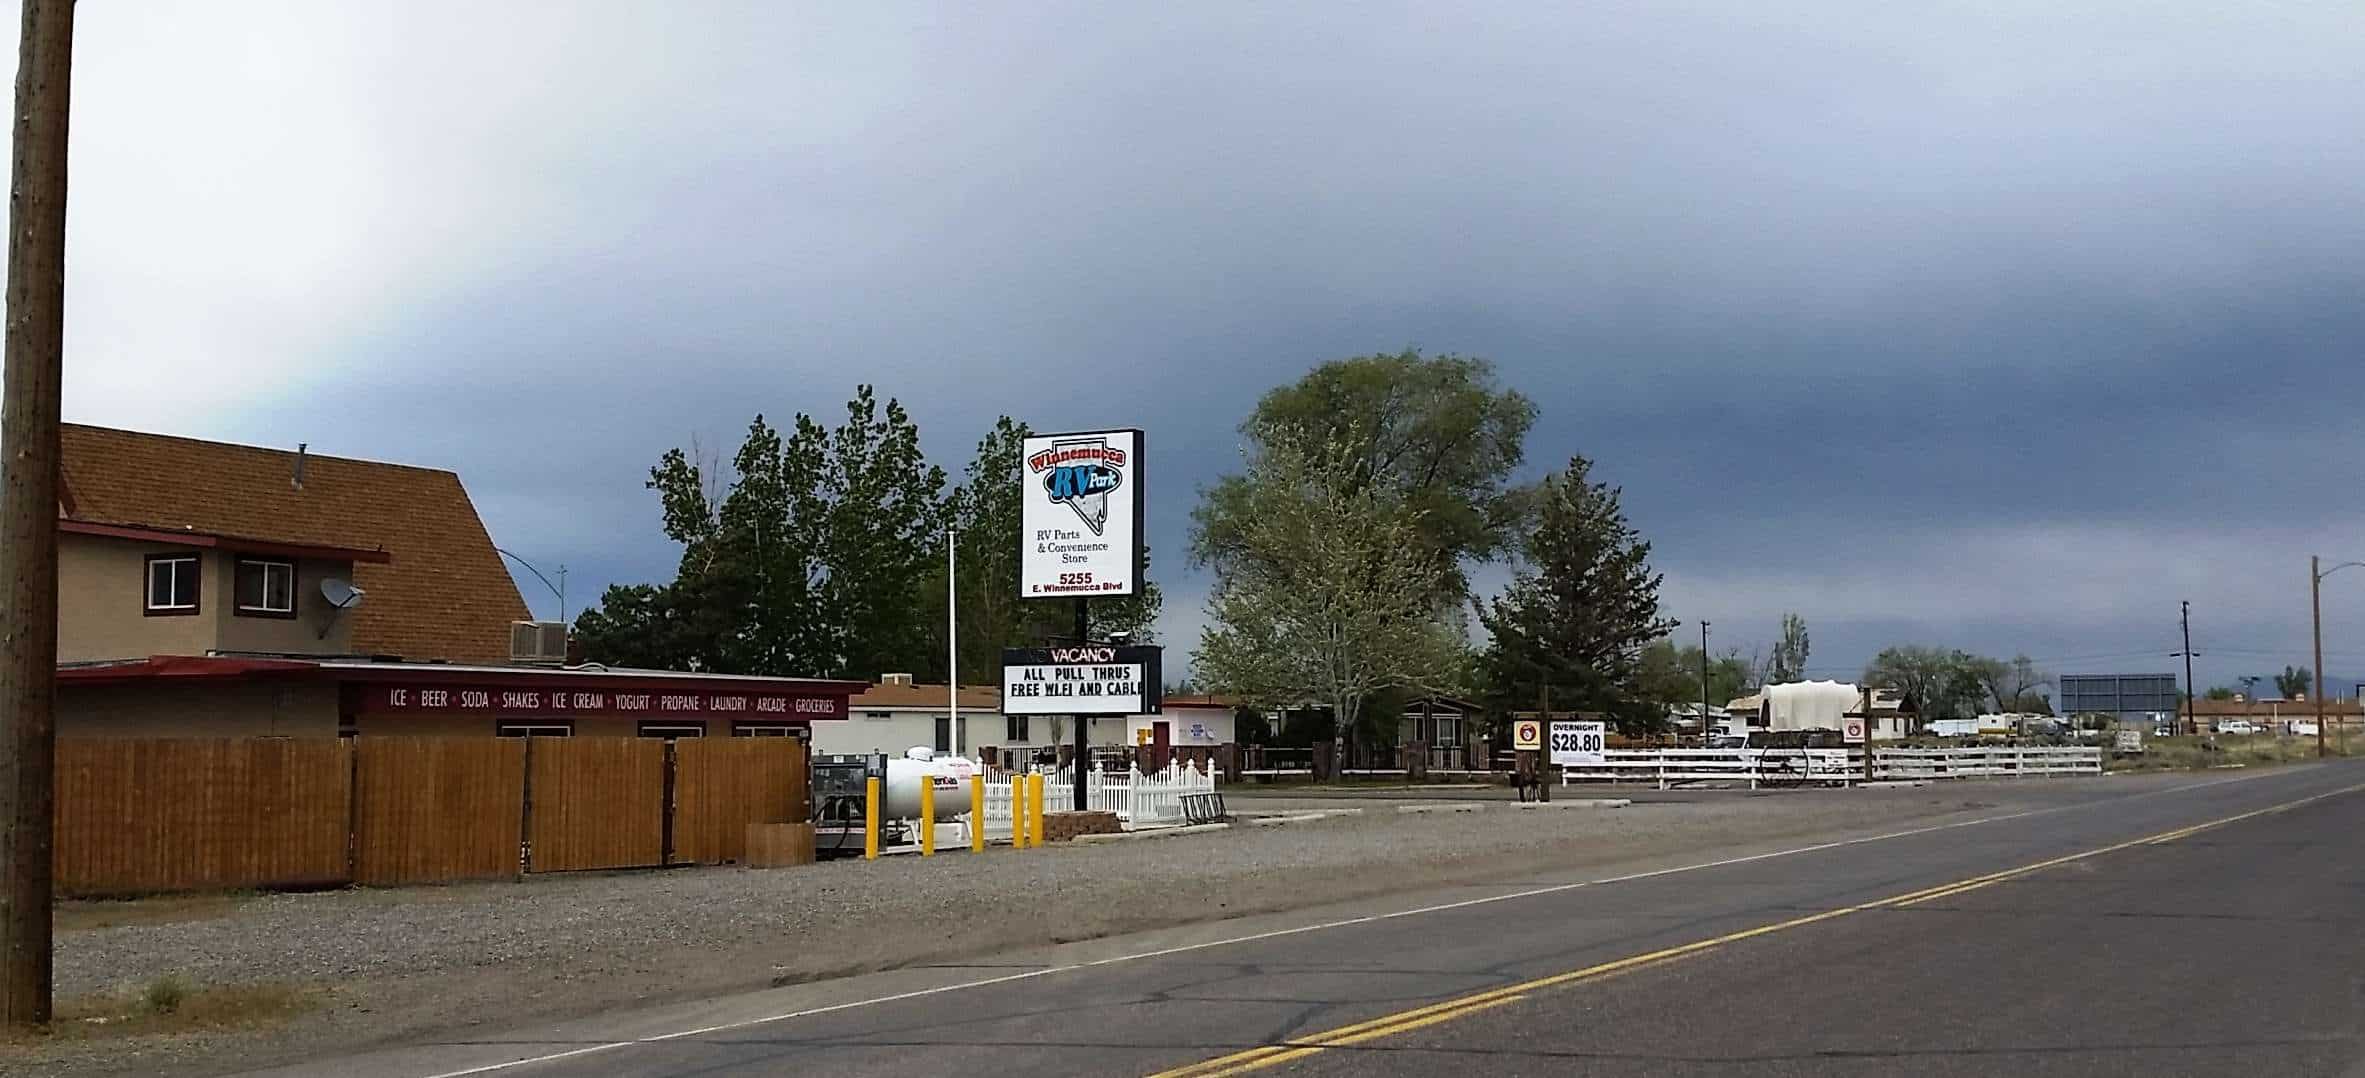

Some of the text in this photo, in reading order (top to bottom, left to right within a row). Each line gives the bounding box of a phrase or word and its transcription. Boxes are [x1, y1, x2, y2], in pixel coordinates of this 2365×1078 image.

[1031, 448, 1124, 470] Winnemucca
[1052, 465, 1117, 498] RV Park
[1037, 529, 1080, 540] RV Parts
[1038, 543, 1109, 553] & Convenience
[1062, 553, 1088, 563] Store
[1060, 573, 1093, 585] 5255
[1044, 583, 1101, 592] Winnemucca
[1103, 582, 1123, 591] Blvd
[1051, 648, 1117, 663] VACANCY
[1024, 667, 1130, 681] ALL PULL THRUS
[1011, 683, 1040, 697] FREE
[1079, 682, 1102, 696] AND
[390, 689, 834, 713] ICE BEER SODA SHAKES ICE CREAM YOGURT PROPANE LAUNDRY ARCADE GROCERIES
[1552, 733, 1601, 752] $28.80
